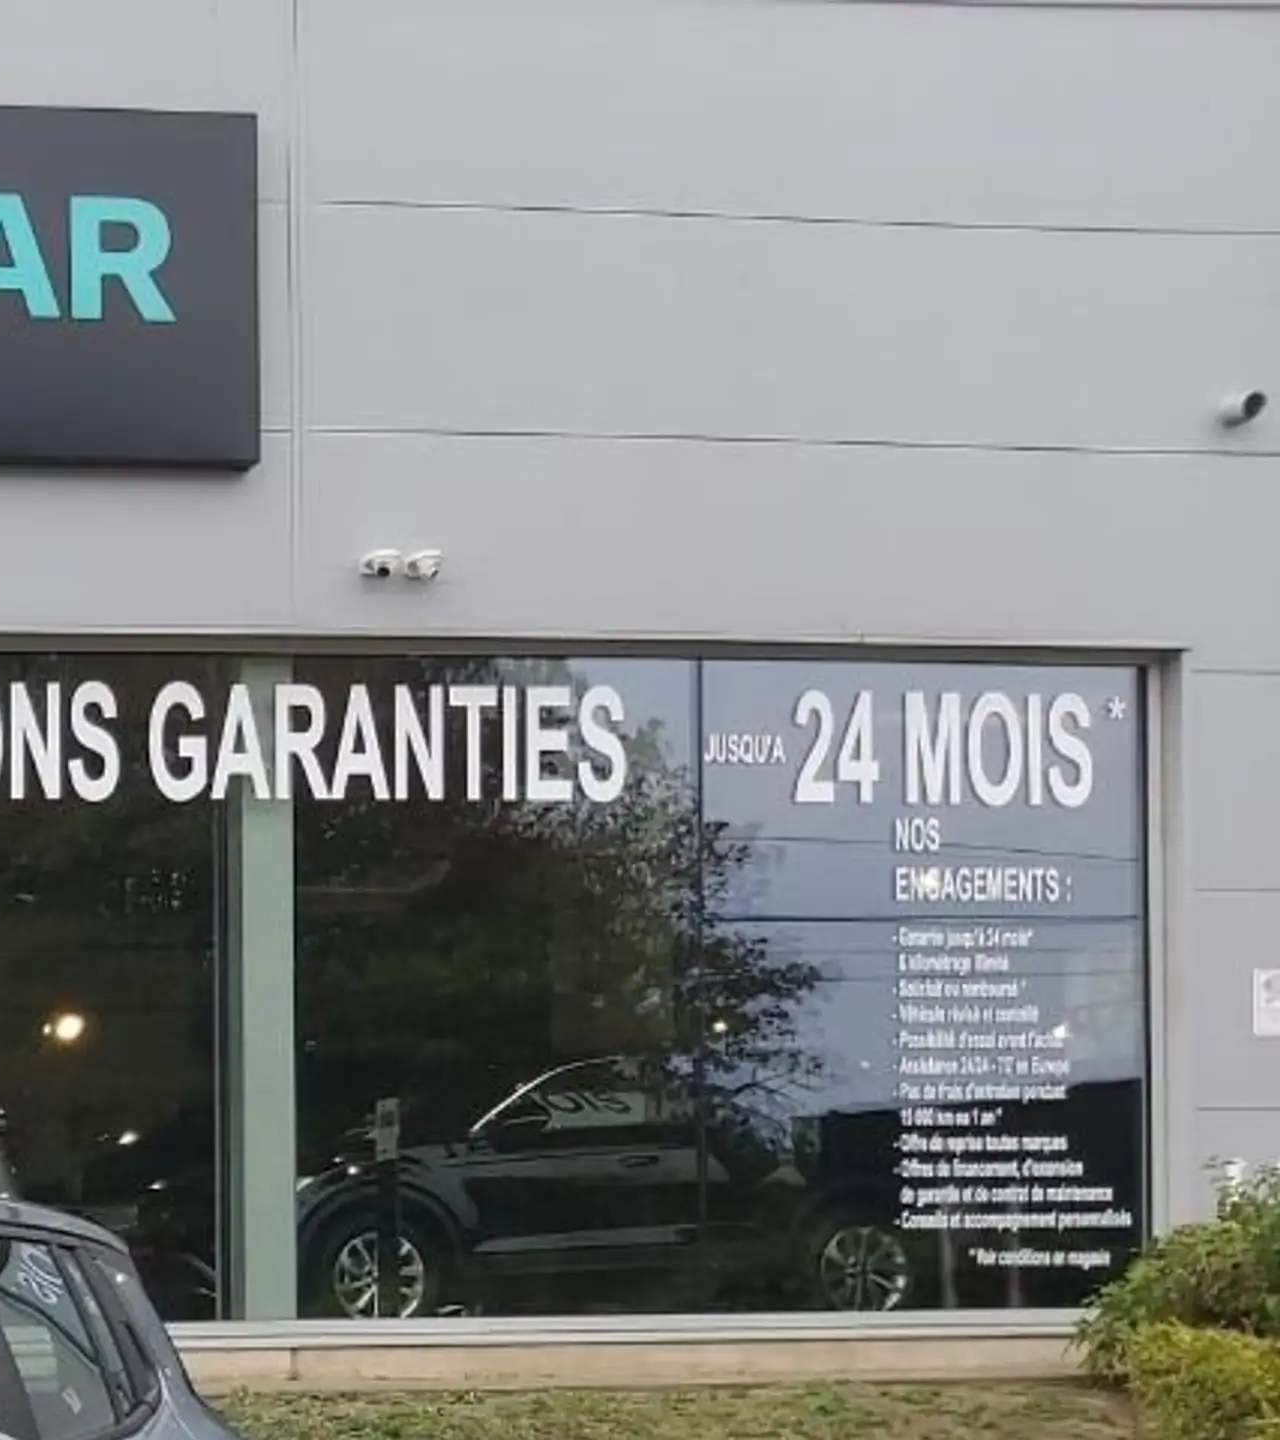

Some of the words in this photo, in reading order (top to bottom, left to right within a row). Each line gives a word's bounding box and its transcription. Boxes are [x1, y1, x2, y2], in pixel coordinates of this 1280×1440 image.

[149, 681, 627, 803] GARANTIES
[703, 733, 787, 766] JUSQU'A
[794, 689, 880, 804] 24
[905, 691, 1094, 809] MOIS
[895, 818, 940, 852] NOS
[895, 867, 1060, 902] ENGAGEMENTS
